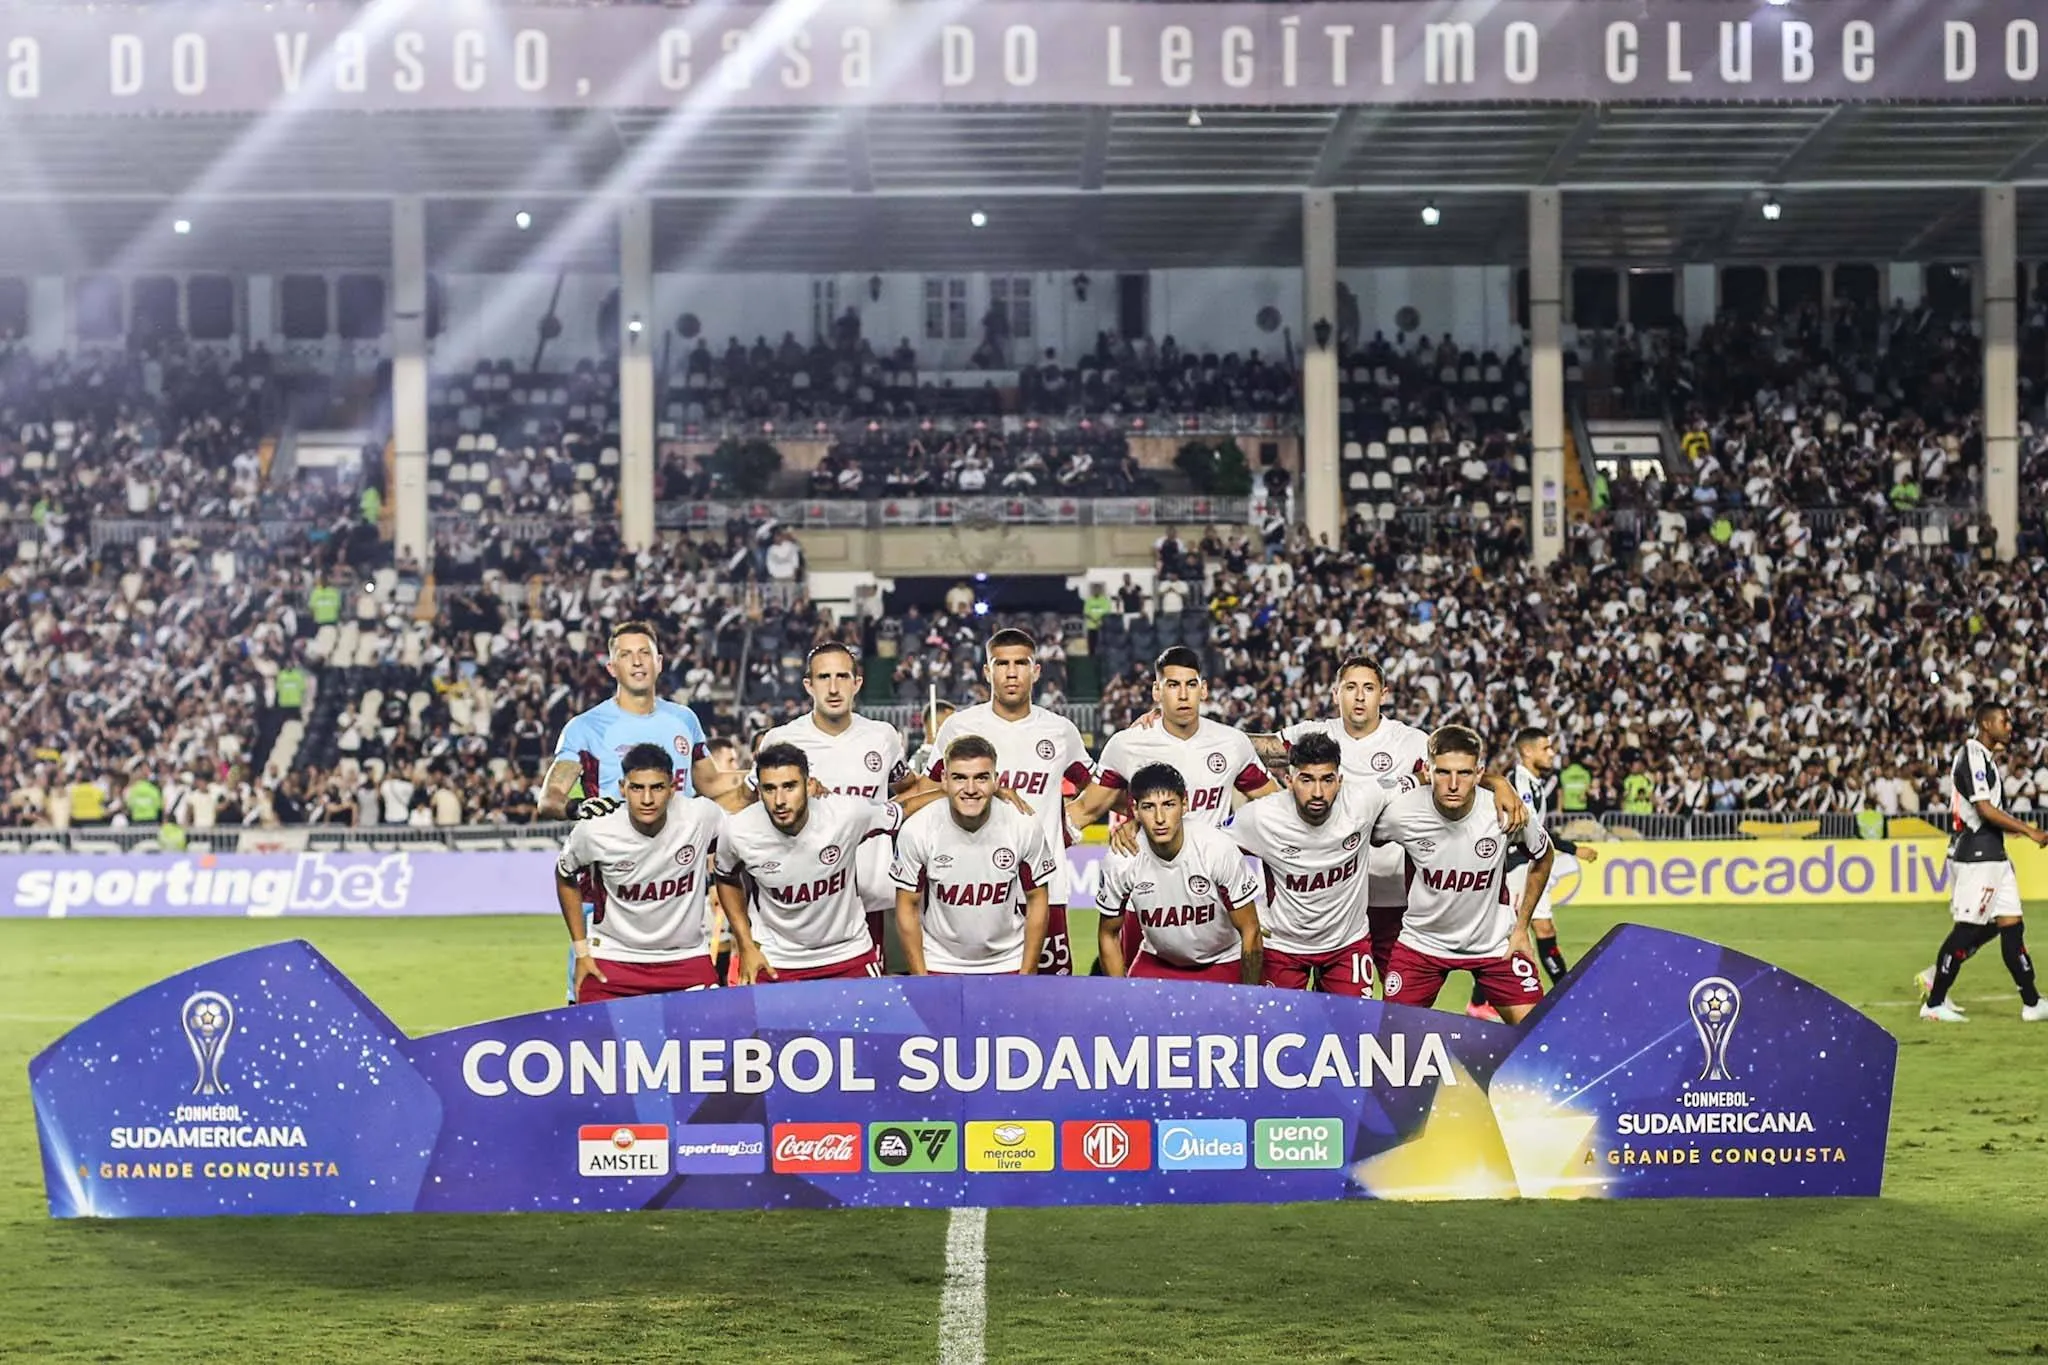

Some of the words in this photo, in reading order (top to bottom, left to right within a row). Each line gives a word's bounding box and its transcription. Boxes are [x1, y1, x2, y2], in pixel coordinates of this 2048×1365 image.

[110, 33, 207, 96] DO
[943, 25, 1038, 86] DO
[1945, 19, 2039, 82] DO
[999, 770, 1049, 794] APEI
[1286, 855, 1358, 893] MAPEI
[1422, 867, 1496, 892] MAPEI
[1603, 845, 1875, 895] mercado
[14, 852, 413, 917] sportingbet
[616, 870, 695, 901] MAPEI
[771, 868, 846, 904] MAPEI
[937, 878, 1016, 906] MAPEI
[1140, 903, 1215, 928] MAPEI
[1352, 952, 1374, 985] 10
[1512, 957, 1533, 977] 6
[462, 1036, 876, 1097] CONMEBOL
[898, 1032, 1458, 1092] SUDAMERICANA
[1269, 1126, 1328, 1140] ueno
[1617, 1111, 1815, 1135] SUDAMERICANA
[110, 1125, 308, 1149] SUDAMERICANA
[678, 1141, 763, 1157] sportingbet
[881, 1136, 907, 1149] EA
[1087, 1126, 1126, 1164] MG
[1170, 1134, 1244, 1158] Midea
[590, 1154, 659, 1170] AMSTEL
[879, 1149, 908, 1157] SPORTS
[984, 1148, 1036, 1159] mercado
[1269, 1141, 1328, 1161] bank
[1584, 1150, 1595, 1165] A
[1607, 1149, 1701, 1165] GRANDE
[1710, 1148, 1847, 1166] CONQUISTA
[99, 1162, 193, 1179] GRANDE
[203, 1162, 340, 1180] CONQUISTA
[997, 1159, 1022, 1169] livre
